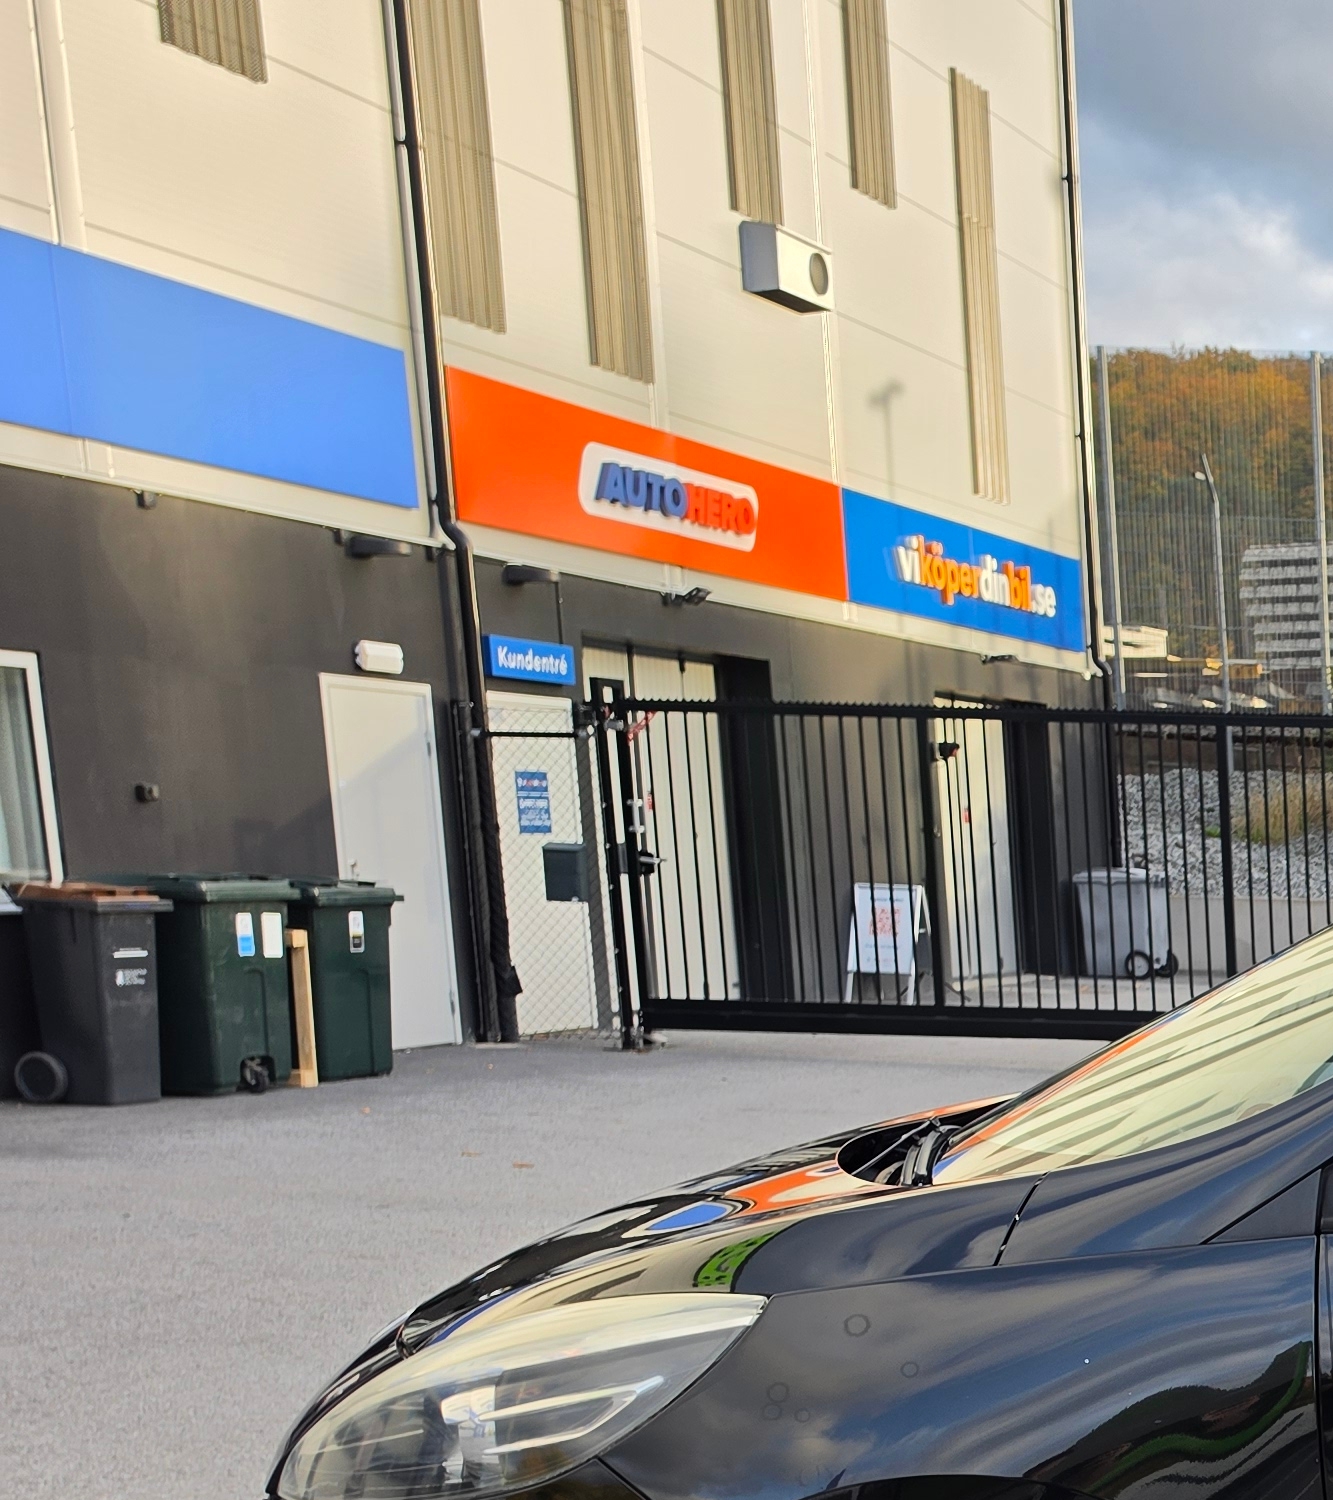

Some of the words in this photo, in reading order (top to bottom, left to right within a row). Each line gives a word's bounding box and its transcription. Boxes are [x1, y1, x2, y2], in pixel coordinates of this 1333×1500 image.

[595, 462, 755, 535] AUTOHERO
[894, 535, 1057, 618] viköperdinbil.se
[497, 645, 568, 676] Kundentré
